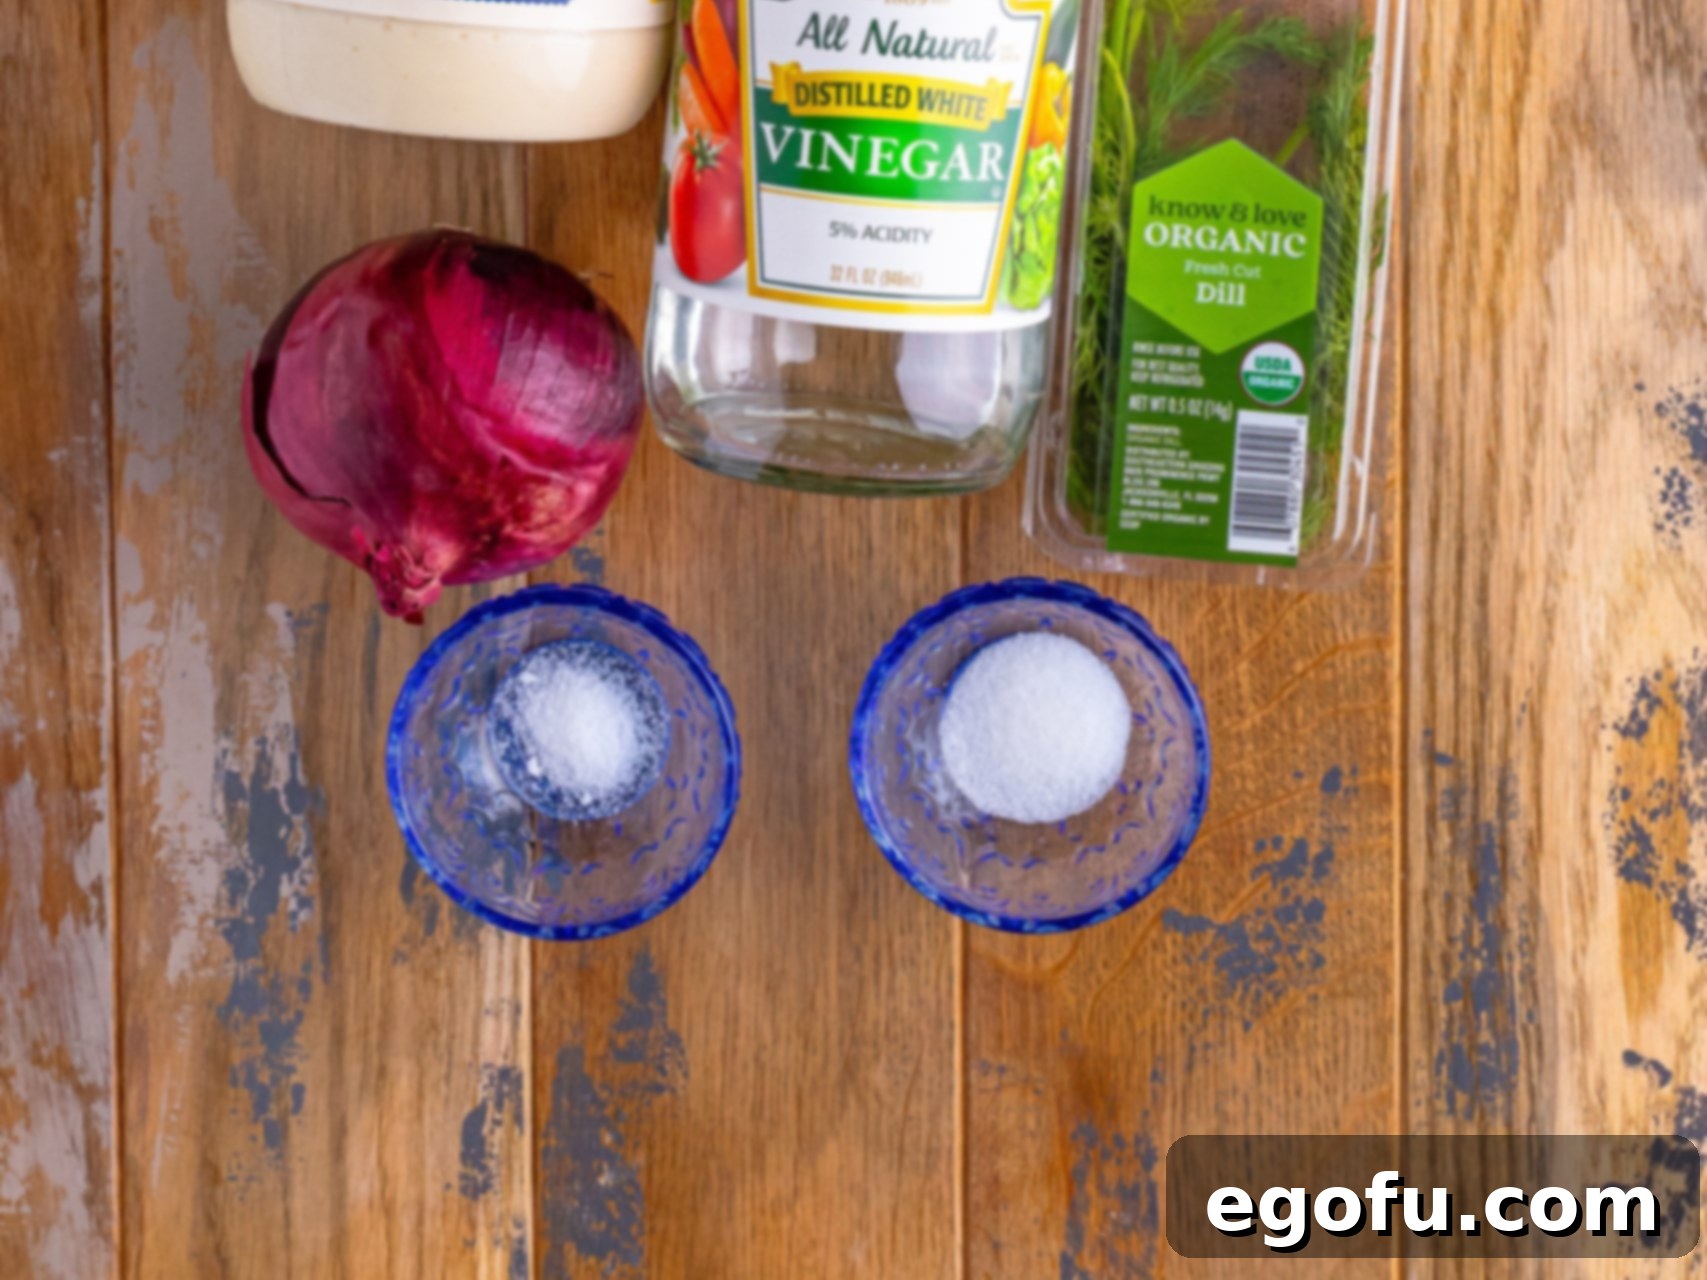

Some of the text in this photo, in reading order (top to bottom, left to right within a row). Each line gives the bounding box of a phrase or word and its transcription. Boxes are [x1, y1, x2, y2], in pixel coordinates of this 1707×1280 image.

[796, 11, 850, 53] All
[860, 17, 998, 64] Natural
[793, 80, 988, 122] DISTILLED WHITE
[759, 122, 1004, 182] VINEGAR
[1148, 195, 1307, 229] know & love
[828, 220, 933, 243] 5% ACIDITY
[1143, 222, 1307, 259] ORGANIC
[847, 266, 858, 284] FL
[1183, 259, 1262, 280] Fresh Cut
[1195, 282, 1246, 307] Dill
[1254, 355, 1293, 372] USDA
